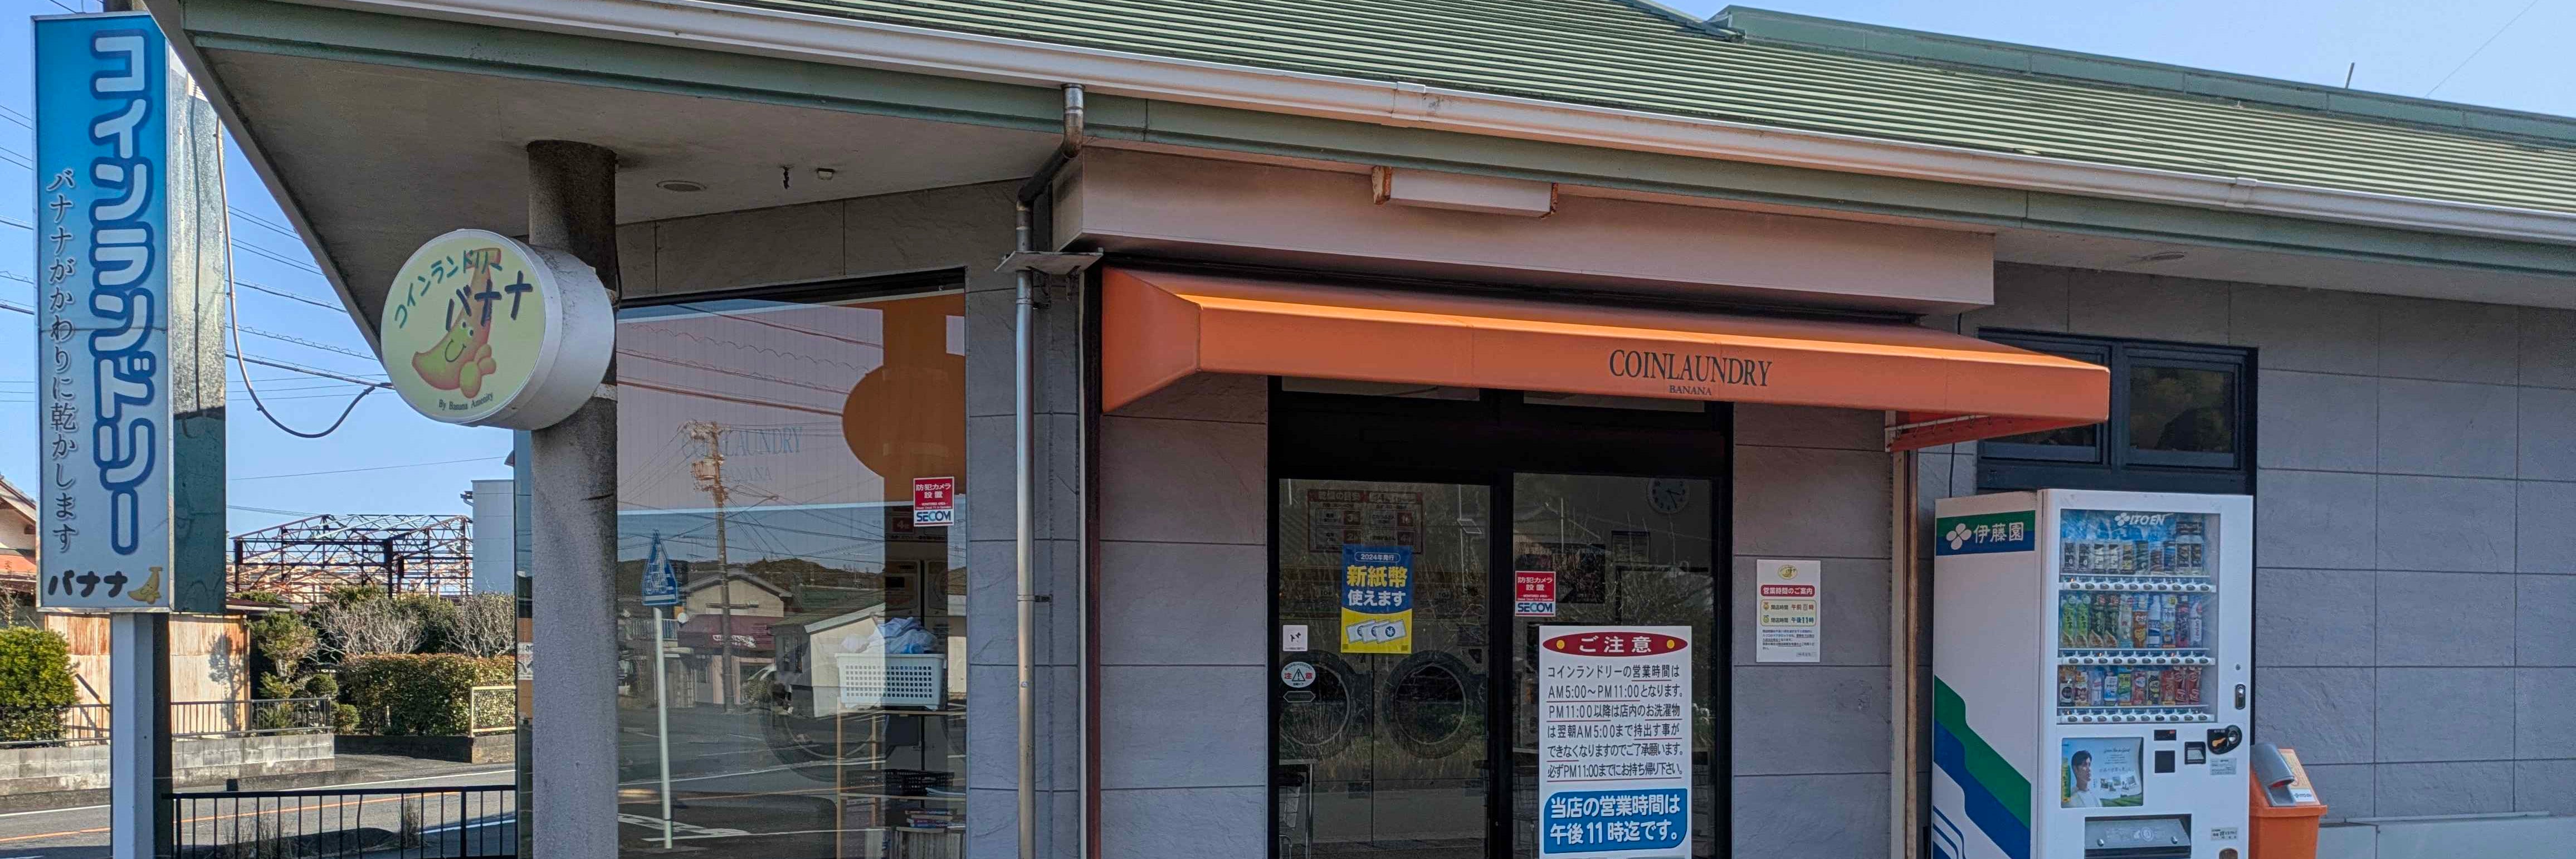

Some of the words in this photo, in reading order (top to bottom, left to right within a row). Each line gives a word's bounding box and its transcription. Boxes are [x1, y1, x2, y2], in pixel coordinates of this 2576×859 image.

[91, 31, 154, 554] コインランドリー
[394, 250, 502, 329] コインランドリー
[446, 270, 533, 332] バナナ
[47, 168, 77, 553] バナナがかわりに乾かします
[1609, 349, 1773, 386] COINLAUNDRY
[1669, 385, 1712, 396] BANANA
[439, 399, 446, 411] By
[449, 401, 468, 410] Banana
[471, 392, 493, 408] Amenity
[916, 483, 952, 491] 防犯カメラ
[916, 511, 951, 522] SECOM
[1973, 522, 2024, 544] 伊藤園
[48, 569, 128, 599] バナナ
[1346, 565, 1408, 588] 新紙幣
[1348, 589, 1406, 607] 使えます
[1518, 602, 1553, 612] SECOM
[1579, 636, 1652, 653] ご注意
[1548, 665, 1680, 679] コインランドリーの営業時間は
[1549, 704, 1681, 718] PM11:00以降は店内のお洗濯物
[1547, 723, 1680, 739] は翌朝AM5:00まで持出す事が
[1548, 743, 1684, 758] できなくなりますのでご了承願います。
[1547, 762, 1683, 778] 必ずPM11:00までにお持ち帰り下さい。
[1551, 794, 1680, 818] 当店の営業時間は
[1550, 819, 1677, 845] 午後11時迄です。
